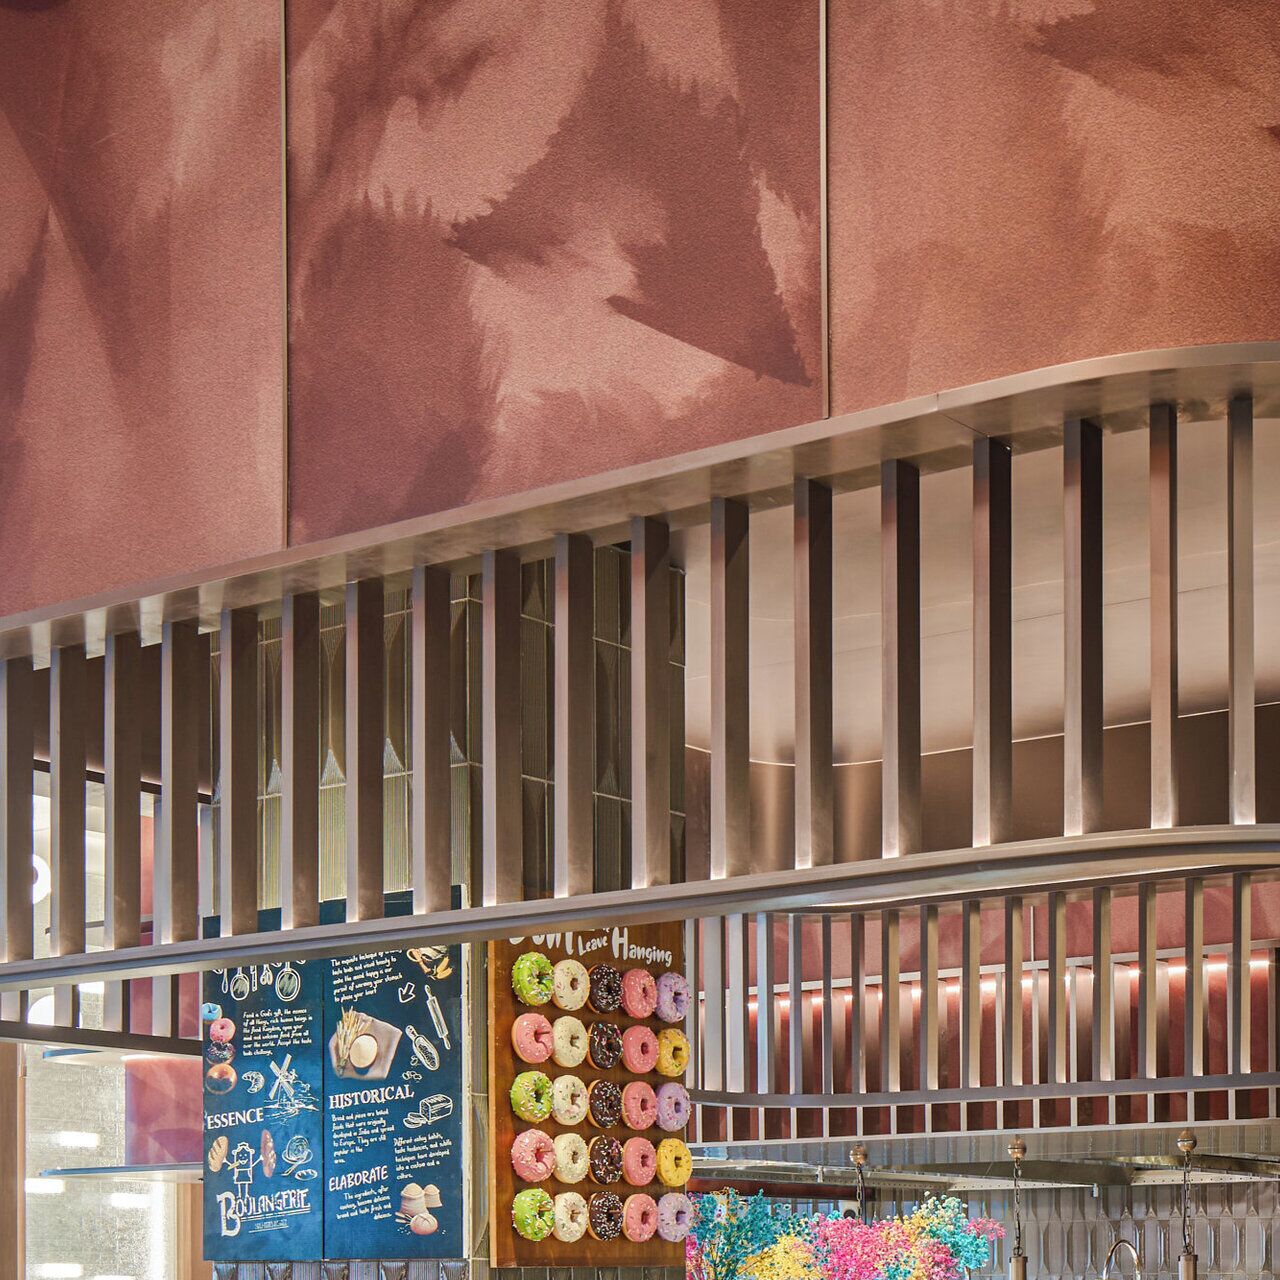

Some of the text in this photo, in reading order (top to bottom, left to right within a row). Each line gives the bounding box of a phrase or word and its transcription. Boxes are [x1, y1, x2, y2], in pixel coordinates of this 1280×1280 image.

[578, 935, 608, 956] Leave
[612, 927, 672, 967] Hanging
[331, 959, 340, 967] The
[376, 958, 390, 967] beauty
[349, 982, 354, 991] of
[373, 979, 383, 988] your
[385, 973, 402, 982] stomach
[353, 992, 364, 1001] your
[329, 1084, 414, 1109] HISTORICAL
[376, 1108, 389, 1116] baked
[357, 1136, 369, 1146] They
[429, 1149, 449, 1157] developed
[329, 1165, 388, 1191] ELABORATE
[378, 1185, 389, 1194] after
[371, 1205, 382, 1213] fresh
